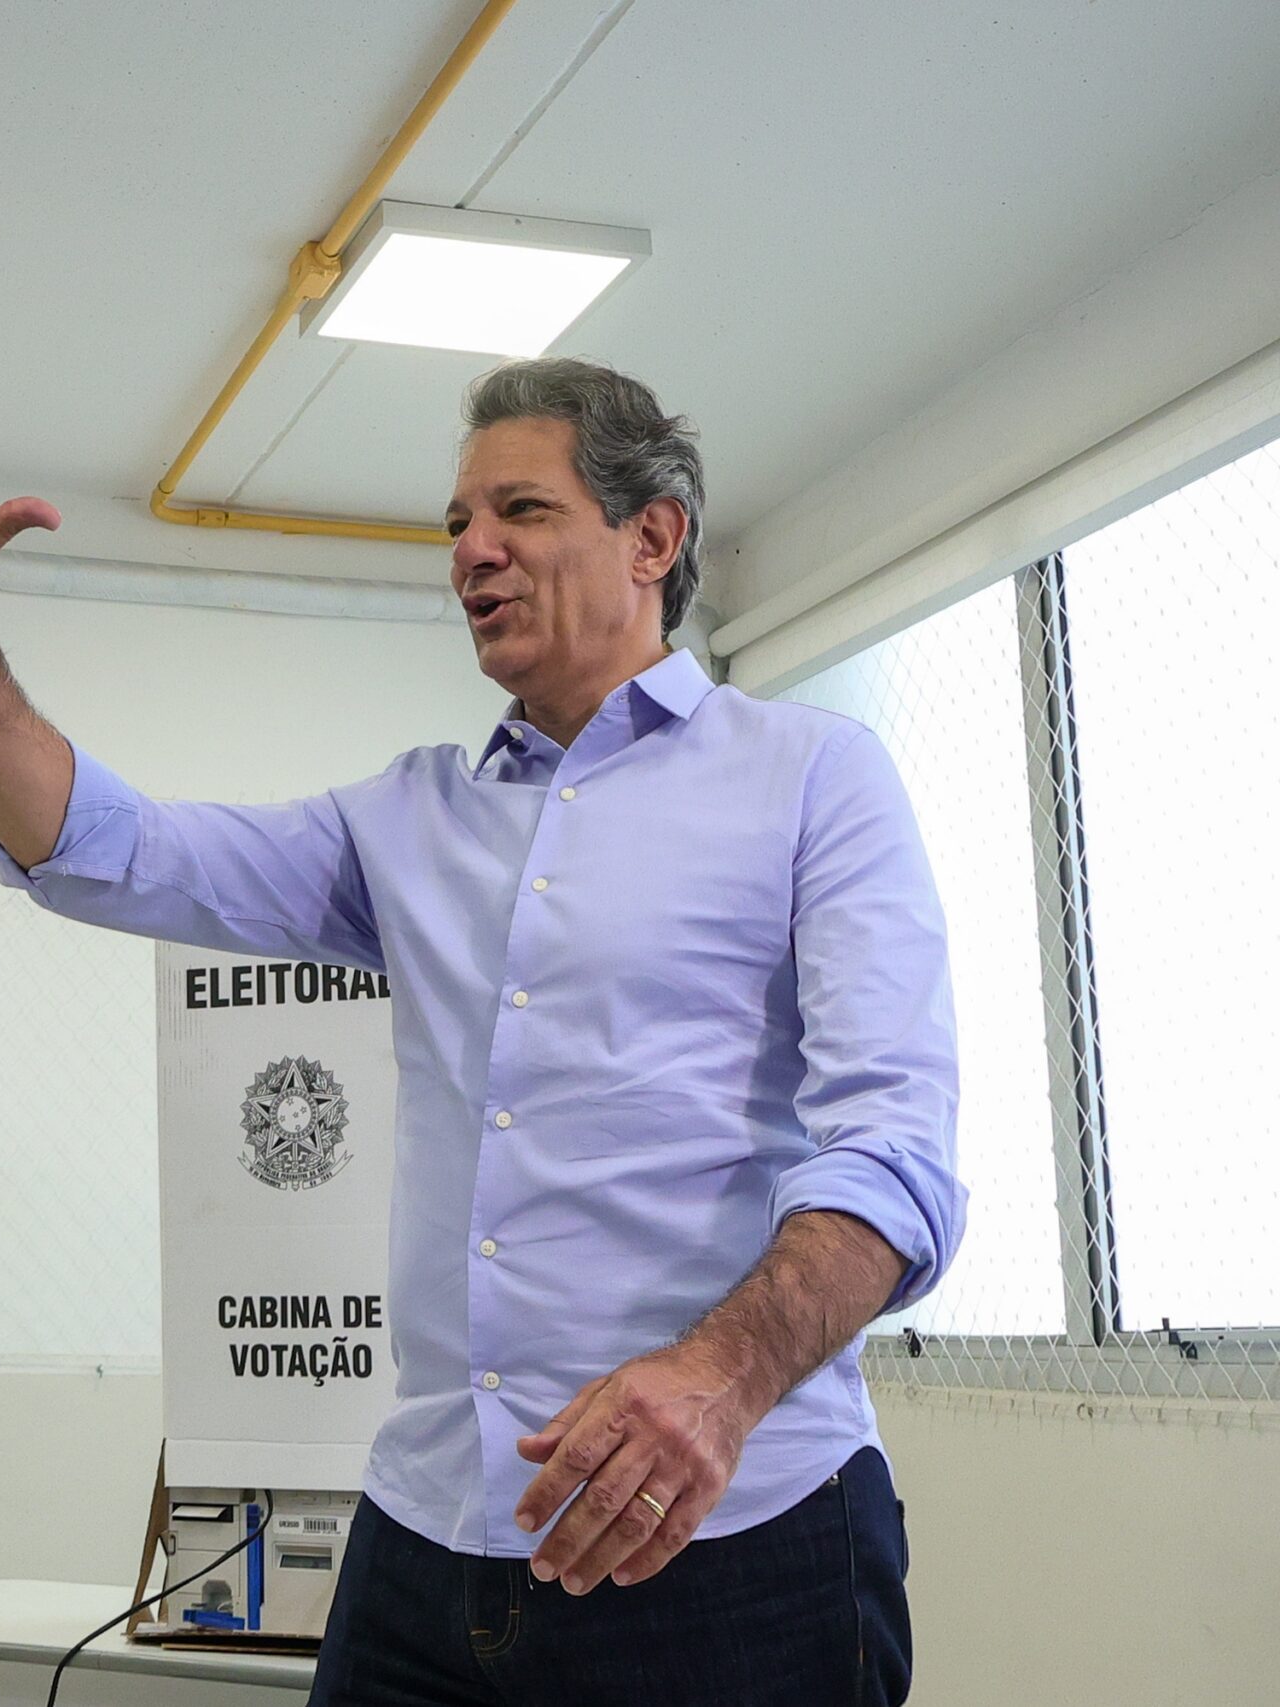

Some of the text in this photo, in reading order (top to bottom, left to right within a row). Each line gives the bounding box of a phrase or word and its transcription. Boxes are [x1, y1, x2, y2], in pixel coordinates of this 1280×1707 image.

[218, 1295, 383, 1329] CABINA DE
[230, 1336, 373, 1387] VOTAÇÃO
